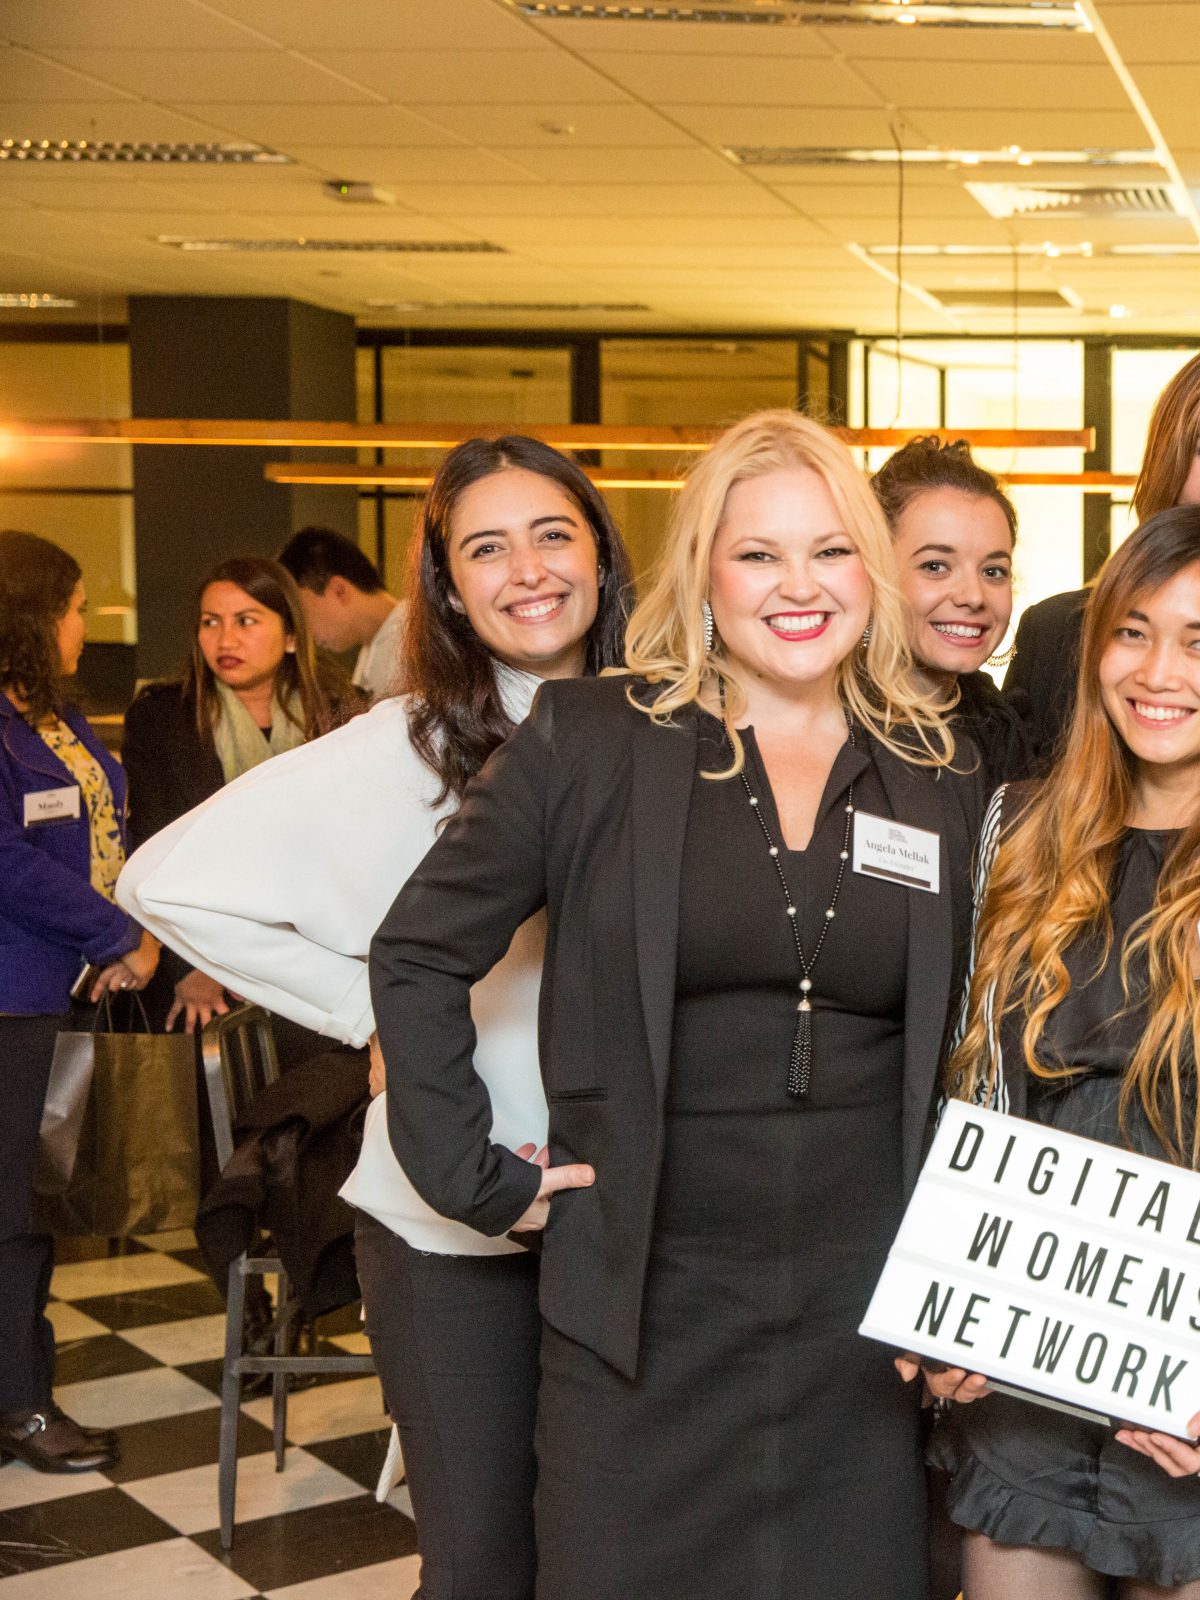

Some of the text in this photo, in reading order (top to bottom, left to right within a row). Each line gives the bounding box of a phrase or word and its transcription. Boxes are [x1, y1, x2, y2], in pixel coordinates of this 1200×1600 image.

[864, 839, 896, 855] Angela
[898, 847, 930, 865] Mellak
[914, 1280, 1189, 1413] NETWORK
